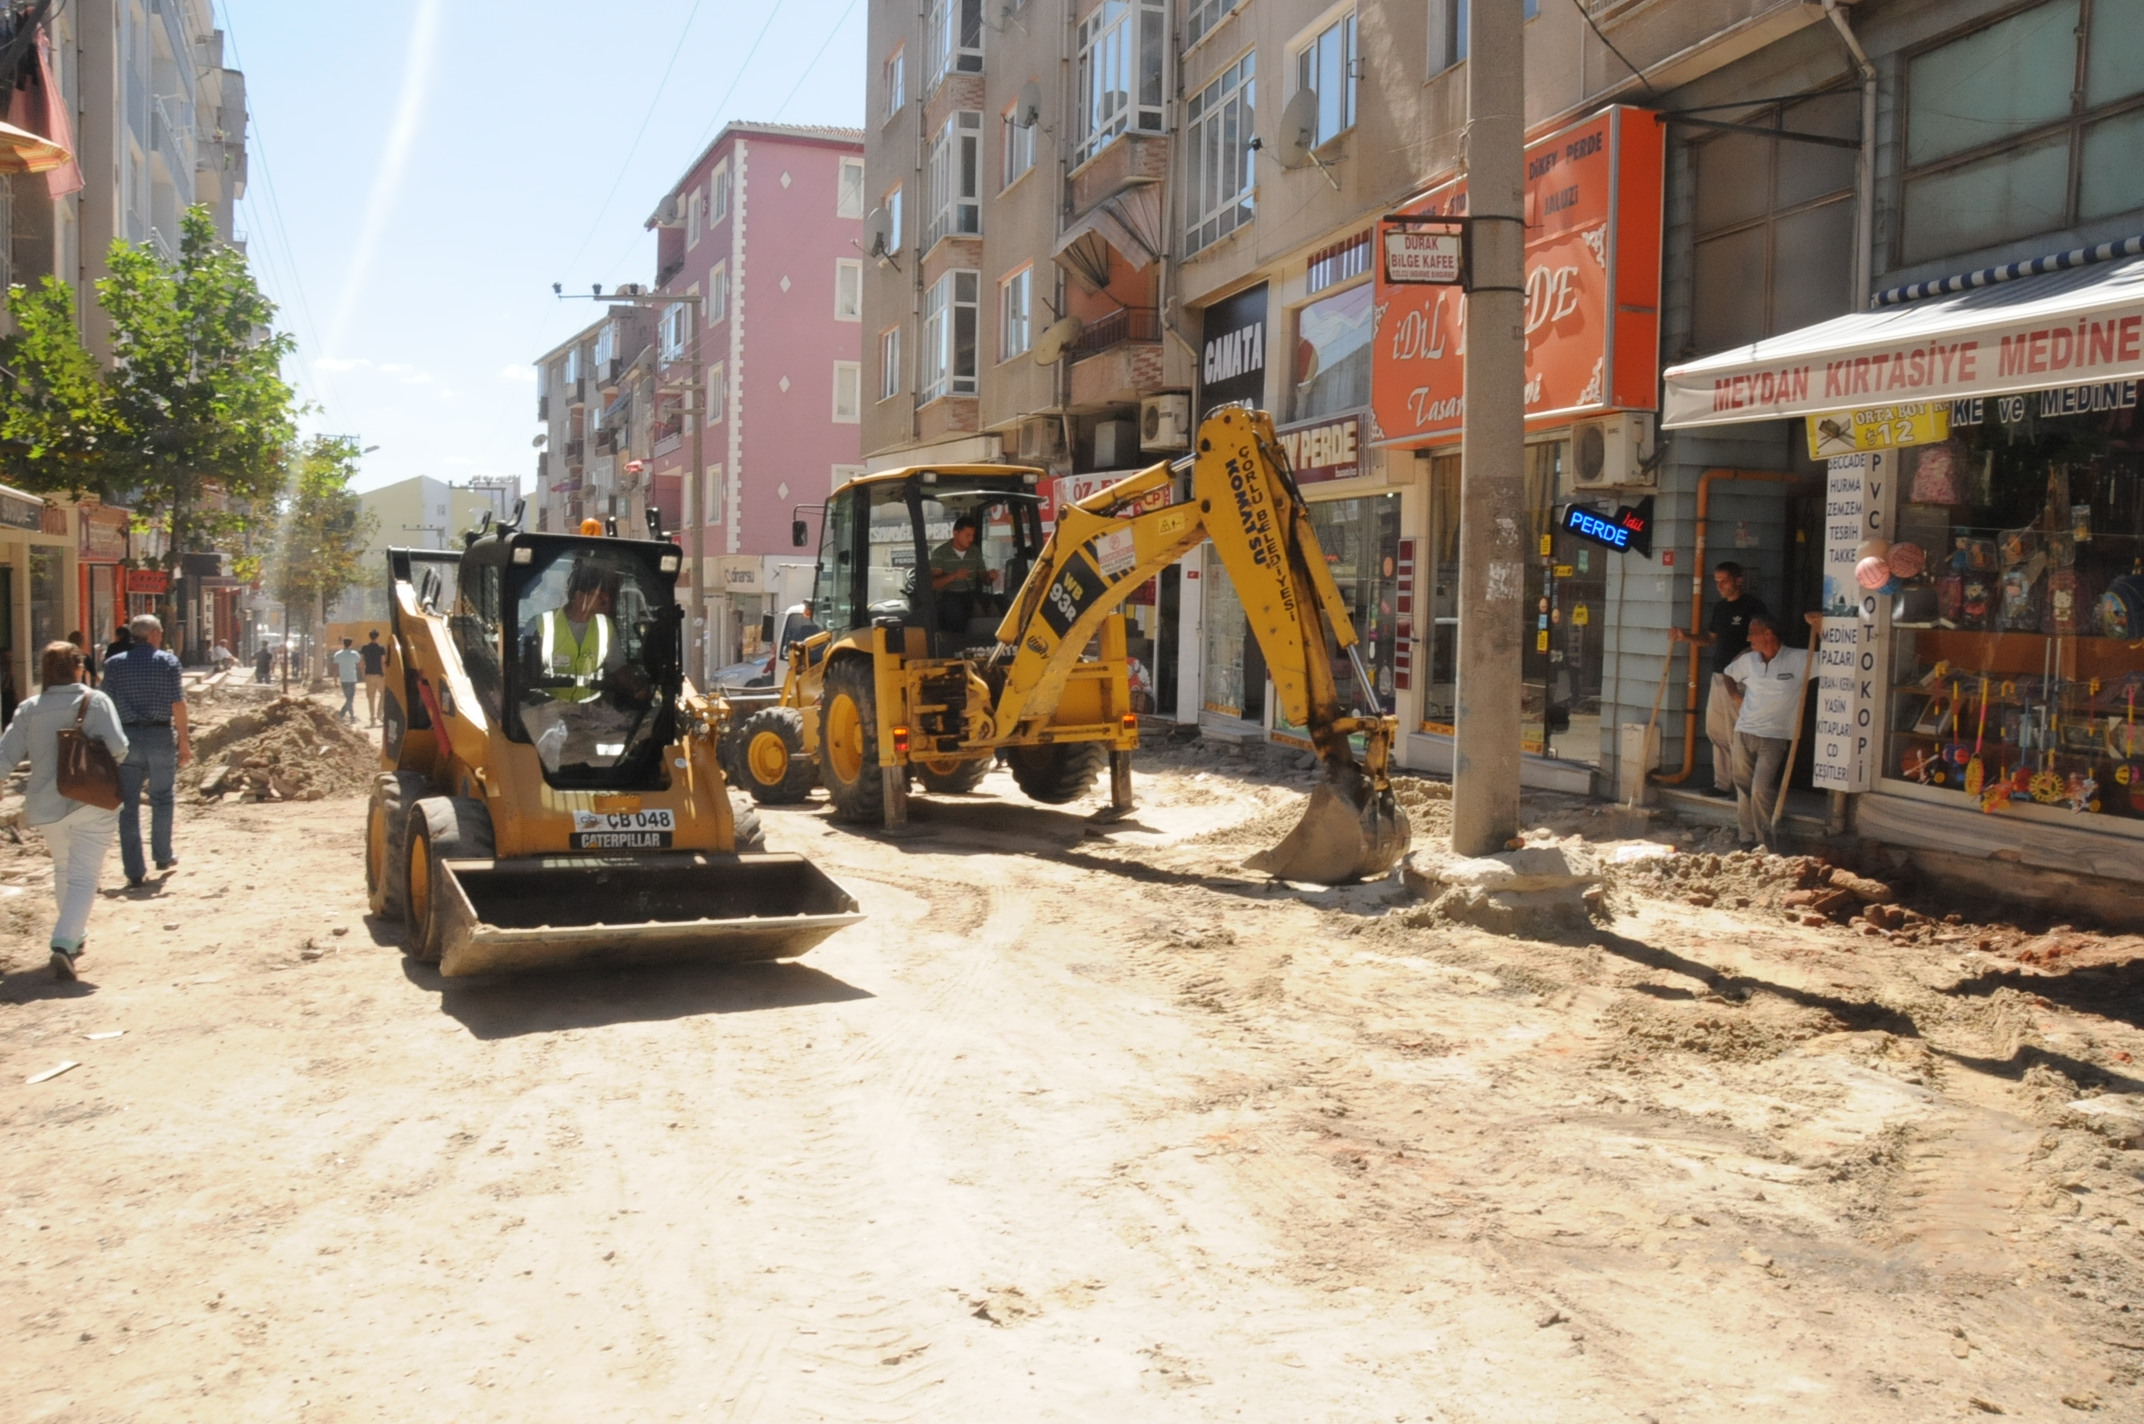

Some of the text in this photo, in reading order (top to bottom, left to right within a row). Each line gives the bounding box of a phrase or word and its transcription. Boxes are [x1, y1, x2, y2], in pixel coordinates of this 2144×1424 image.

[1566, 131, 1603, 165] PERDE
[1405, 236, 1439, 251] DURAK
[1422, 255, 1454, 269] KAFEE
[1713, 315, 2143, 412] MEYDAN KIRTASİYE MEDİNE
[1855, 407, 1895, 425] ORTA
[1896, 403, 1927, 419] BOY
[1997, 395, 2025, 424] ve
[1301, 421, 1358, 469] PERDE
[1829, 477, 1862, 493] HURMA
[1225, 458, 1267, 566] KOMATSU
[1827, 501, 1863, 517] ZEMZEM
[1569, 511, 1629, 547] PERDE
[1829, 522, 1859, 540] TESBİH
[1829, 549, 1857, 563] TAKKE
[1063, 571, 1084, 601] WB
[1049, 582, 1077, 623] 93R
[1821, 624, 1858, 645] MEDİNE
[1821, 650, 1856, 668] PAZARI
[1823, 695, 1847, 714] YASİN
[1826, 743, 1839, 758] CD
[635, 811, 671, 828] 048
[581, 833, 661, 848] CATERPILLAR
